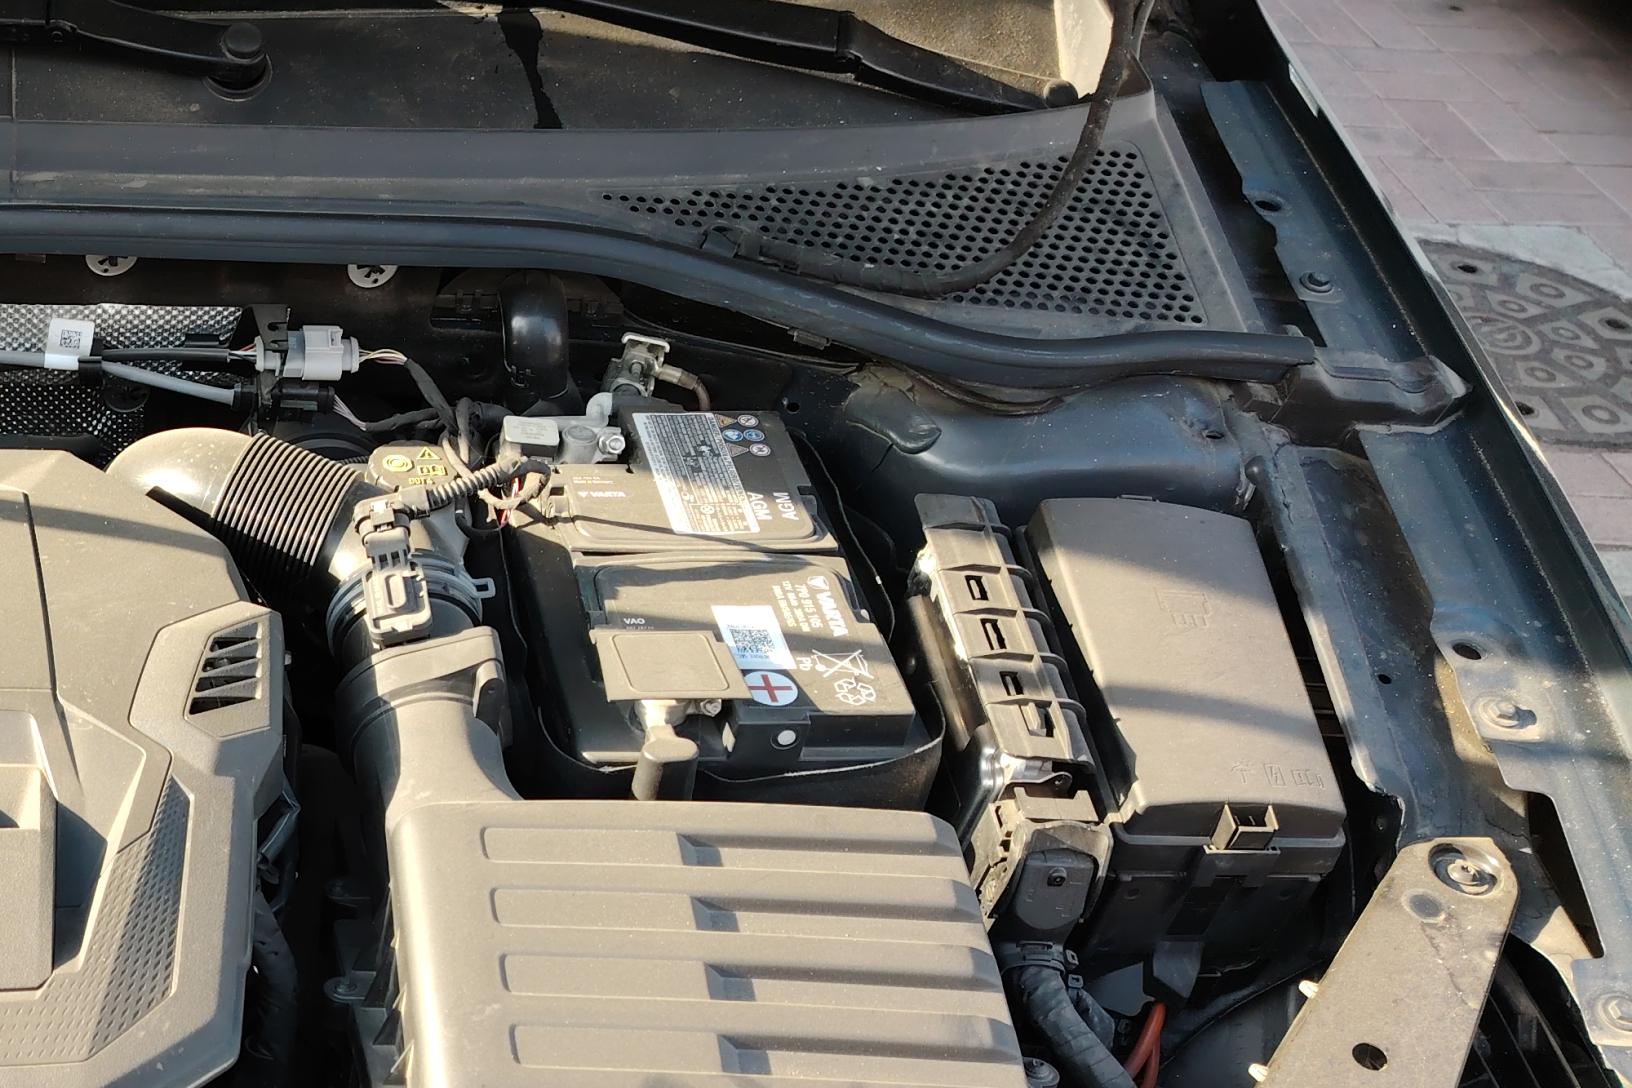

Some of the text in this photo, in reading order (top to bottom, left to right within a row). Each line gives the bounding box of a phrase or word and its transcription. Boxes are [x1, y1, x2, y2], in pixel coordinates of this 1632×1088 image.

[589, 490, 626, 498] VARTA
[747, 492, 773, 520] AGM
[772, 492, 799, 520] AGM
[816, 591, 848, 637] VARTA
[796, 657, 813, 671] Pb
